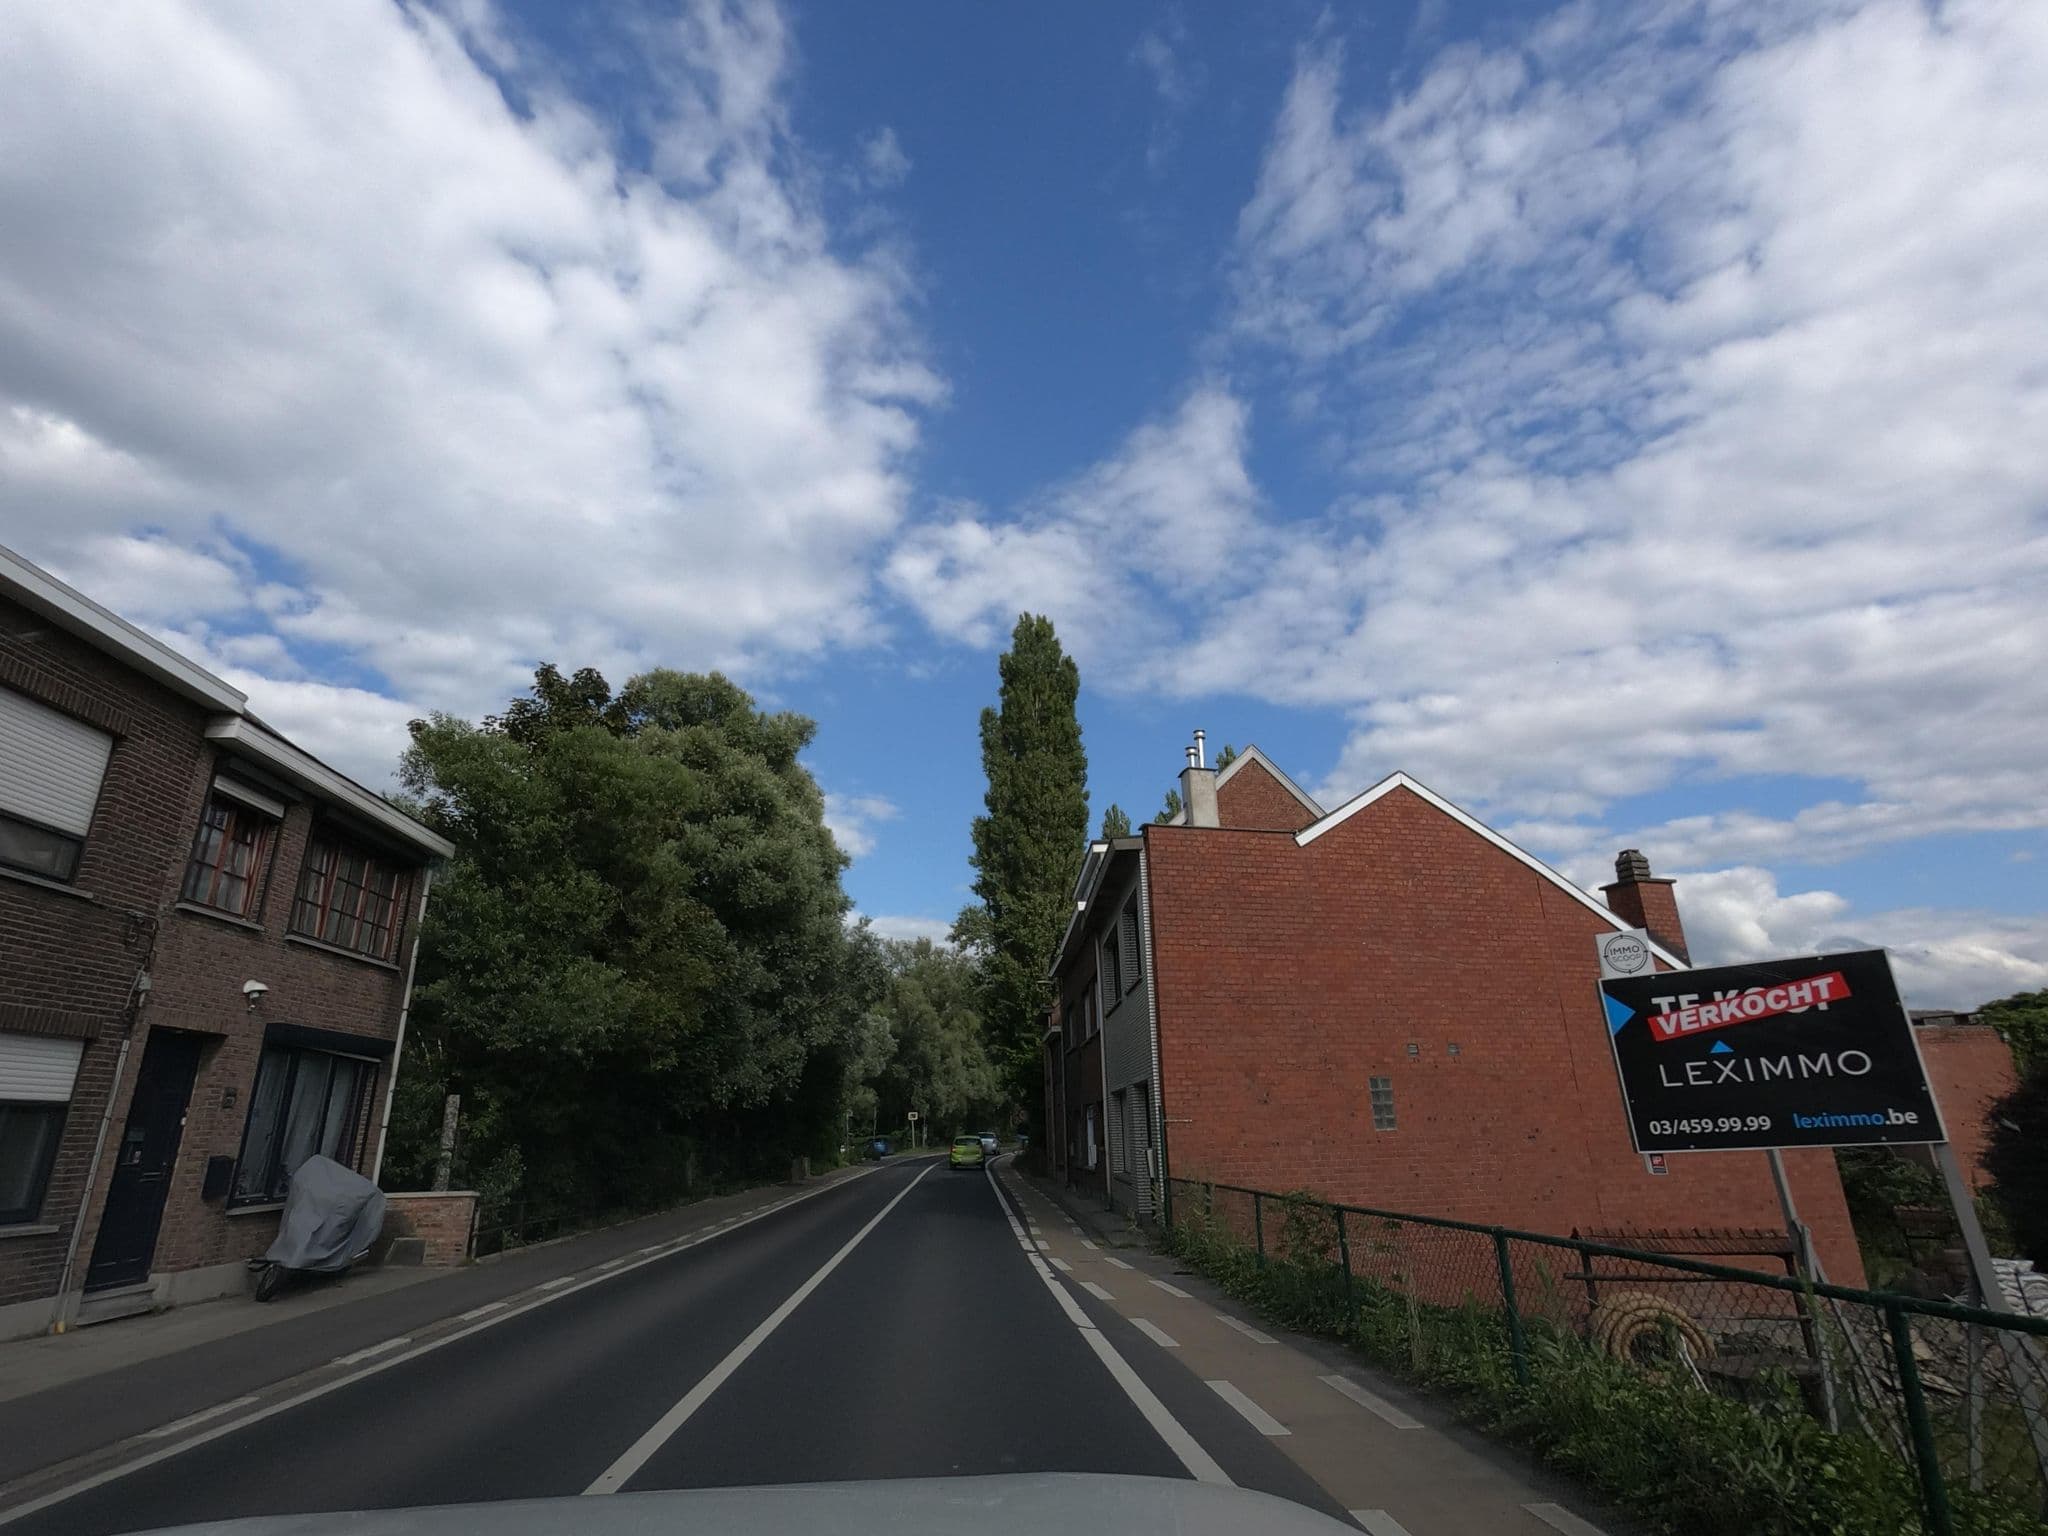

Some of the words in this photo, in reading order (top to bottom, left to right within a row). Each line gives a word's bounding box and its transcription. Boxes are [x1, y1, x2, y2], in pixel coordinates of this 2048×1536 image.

[1610, 945, 1640, 956] IMMO
[1657, 977, 1834, 1035] VERKOCHT
[1658, 1050, 1873, 1088] LEXIMMO
[1649, 1115, 1772, 1137] 03/459.99.99
[1792, 1108, 1919, 1130] leximmo.be
